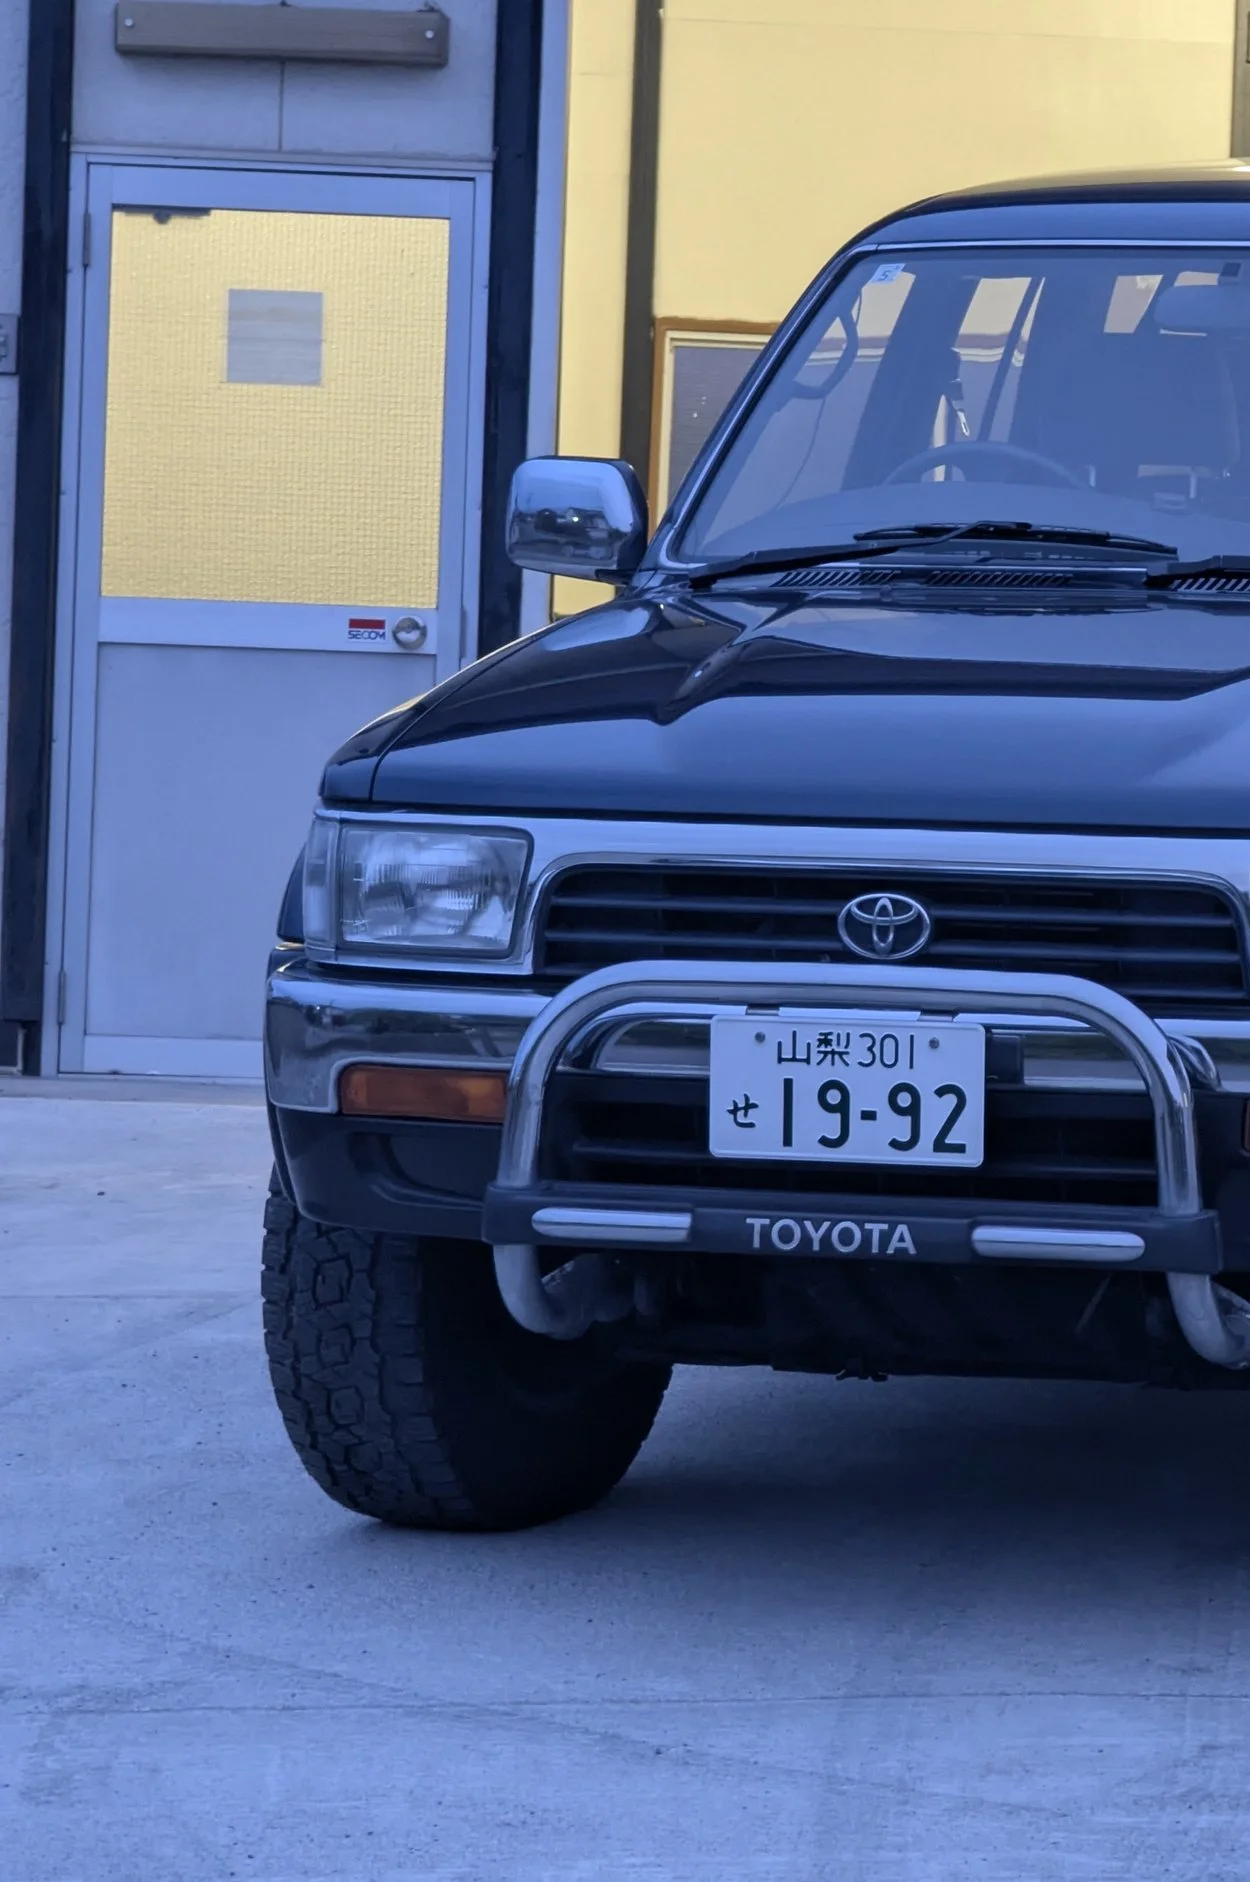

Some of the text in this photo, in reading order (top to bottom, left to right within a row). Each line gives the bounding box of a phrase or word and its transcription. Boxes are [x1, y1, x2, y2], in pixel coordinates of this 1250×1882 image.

[348, 630, 386, 640] SECOM
[727, 1077, 967, 1154] せ 19-92
[746, 1217, 917, 1254] TOYOTA
